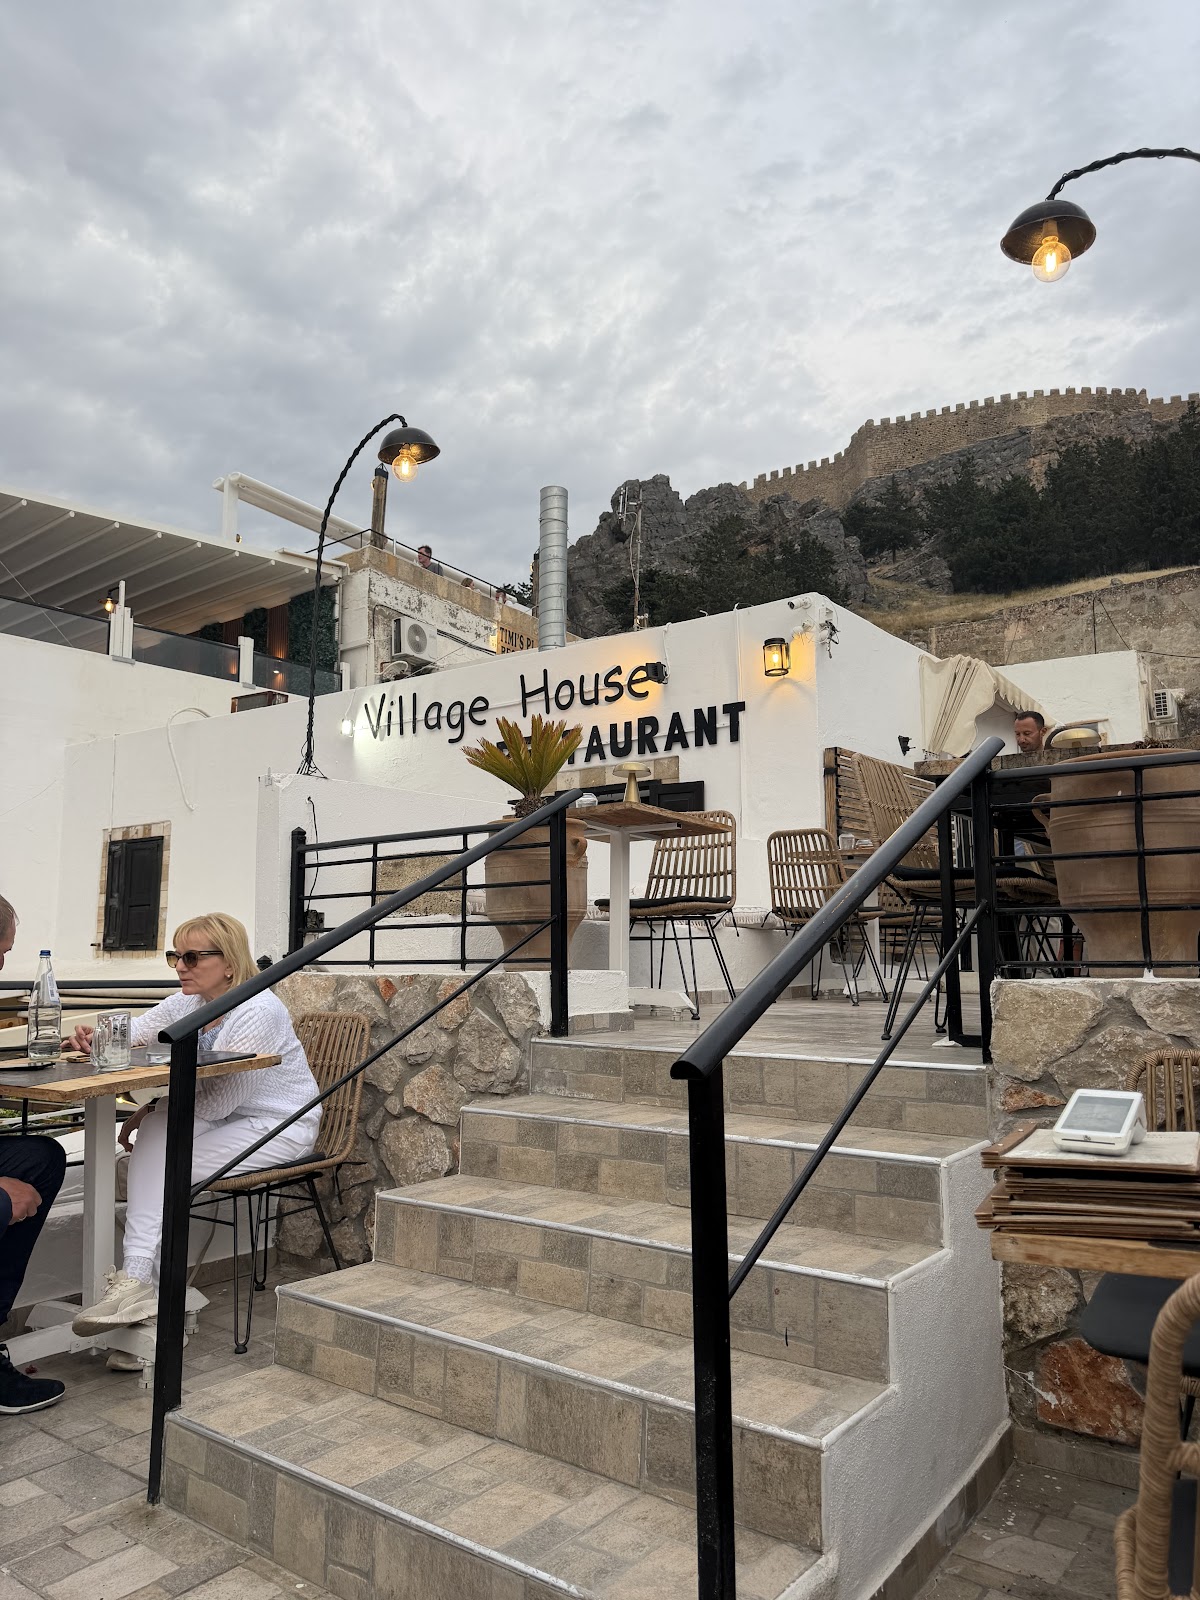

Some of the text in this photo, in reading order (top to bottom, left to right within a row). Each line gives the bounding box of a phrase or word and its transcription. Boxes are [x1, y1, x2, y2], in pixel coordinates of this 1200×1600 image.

[499, 626, 525, 651] TIMI'S
[364, 662, 650, 744] Village House
[496, 700, 747, 767] AURANT
